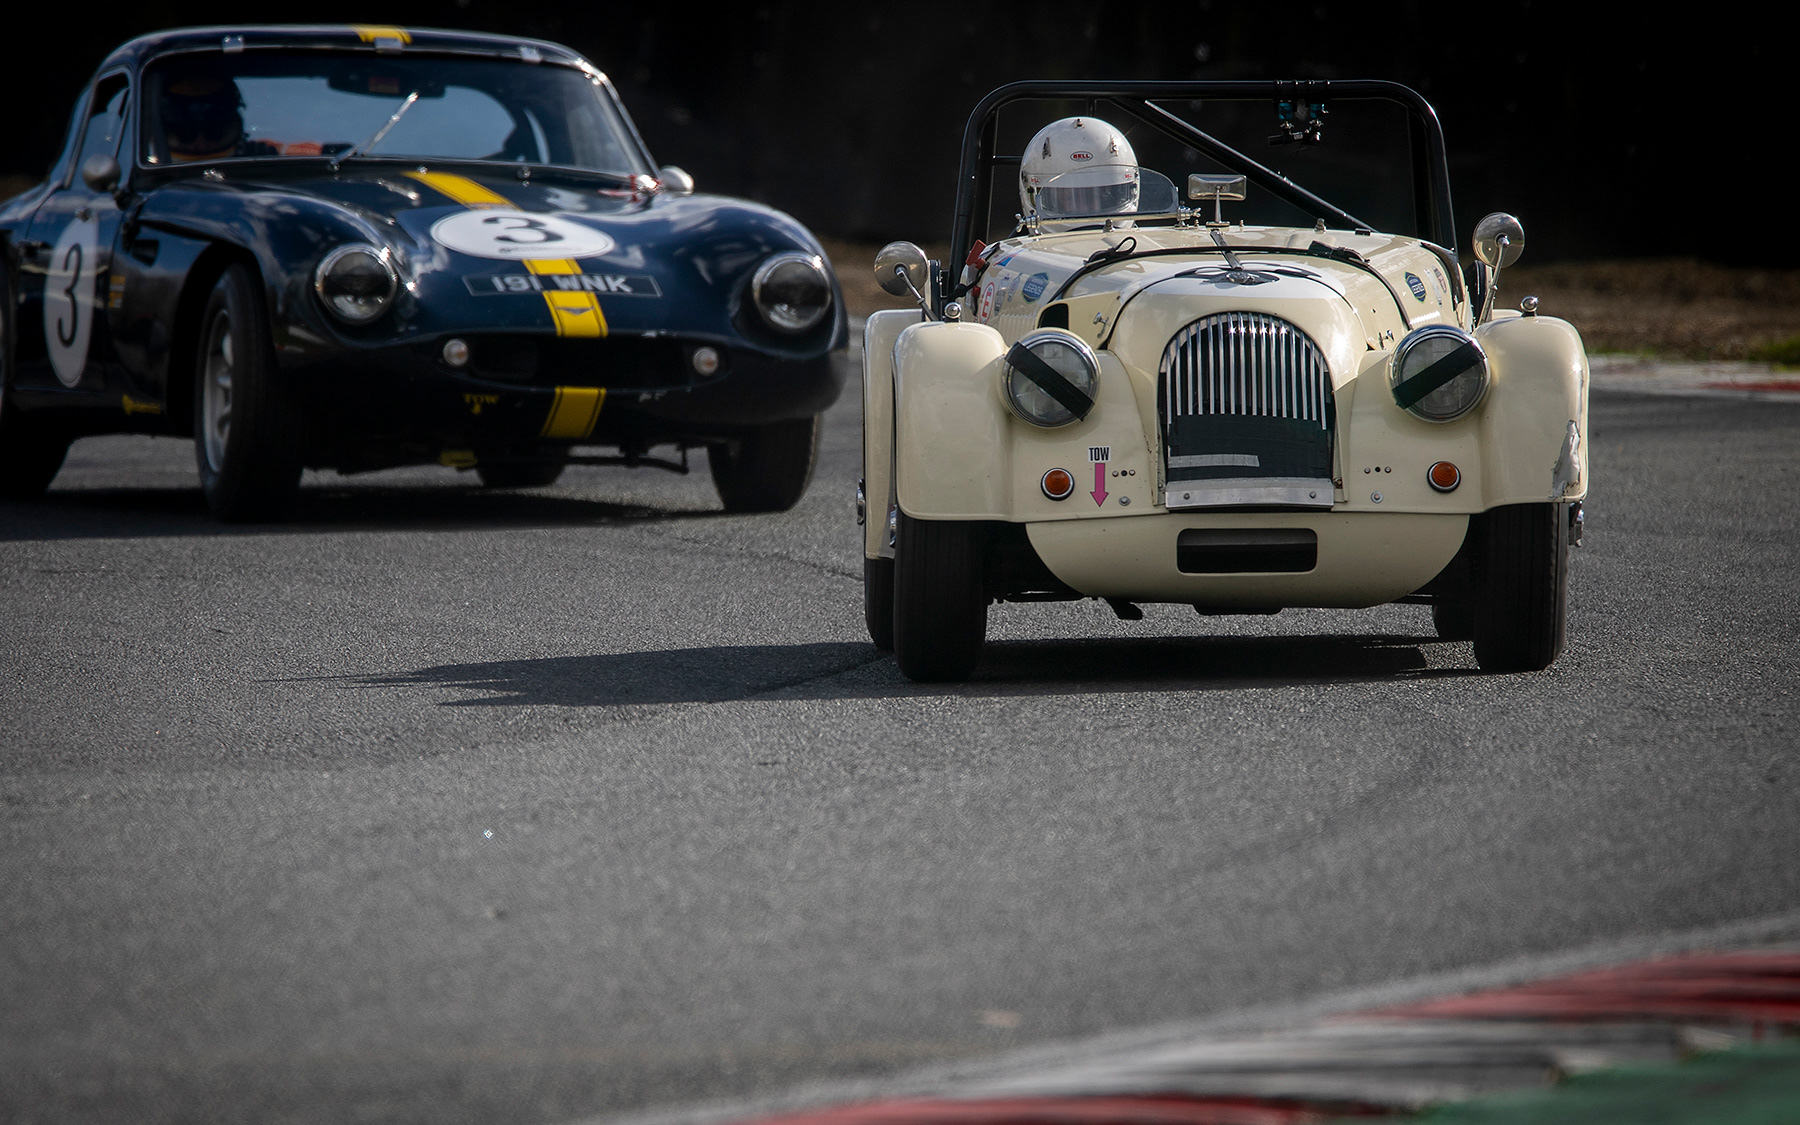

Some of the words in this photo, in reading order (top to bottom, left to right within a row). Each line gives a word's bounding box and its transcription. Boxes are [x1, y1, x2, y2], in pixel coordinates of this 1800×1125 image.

[482, 216, 564, 243] 3
[491, 275, 543, 292] 191
[551, 275, 633, 293] WNK
[57, 242, 83, 347] 3
[464, 393, 500, 404] TOW
[1088, 447, 1110, 461] TOW
